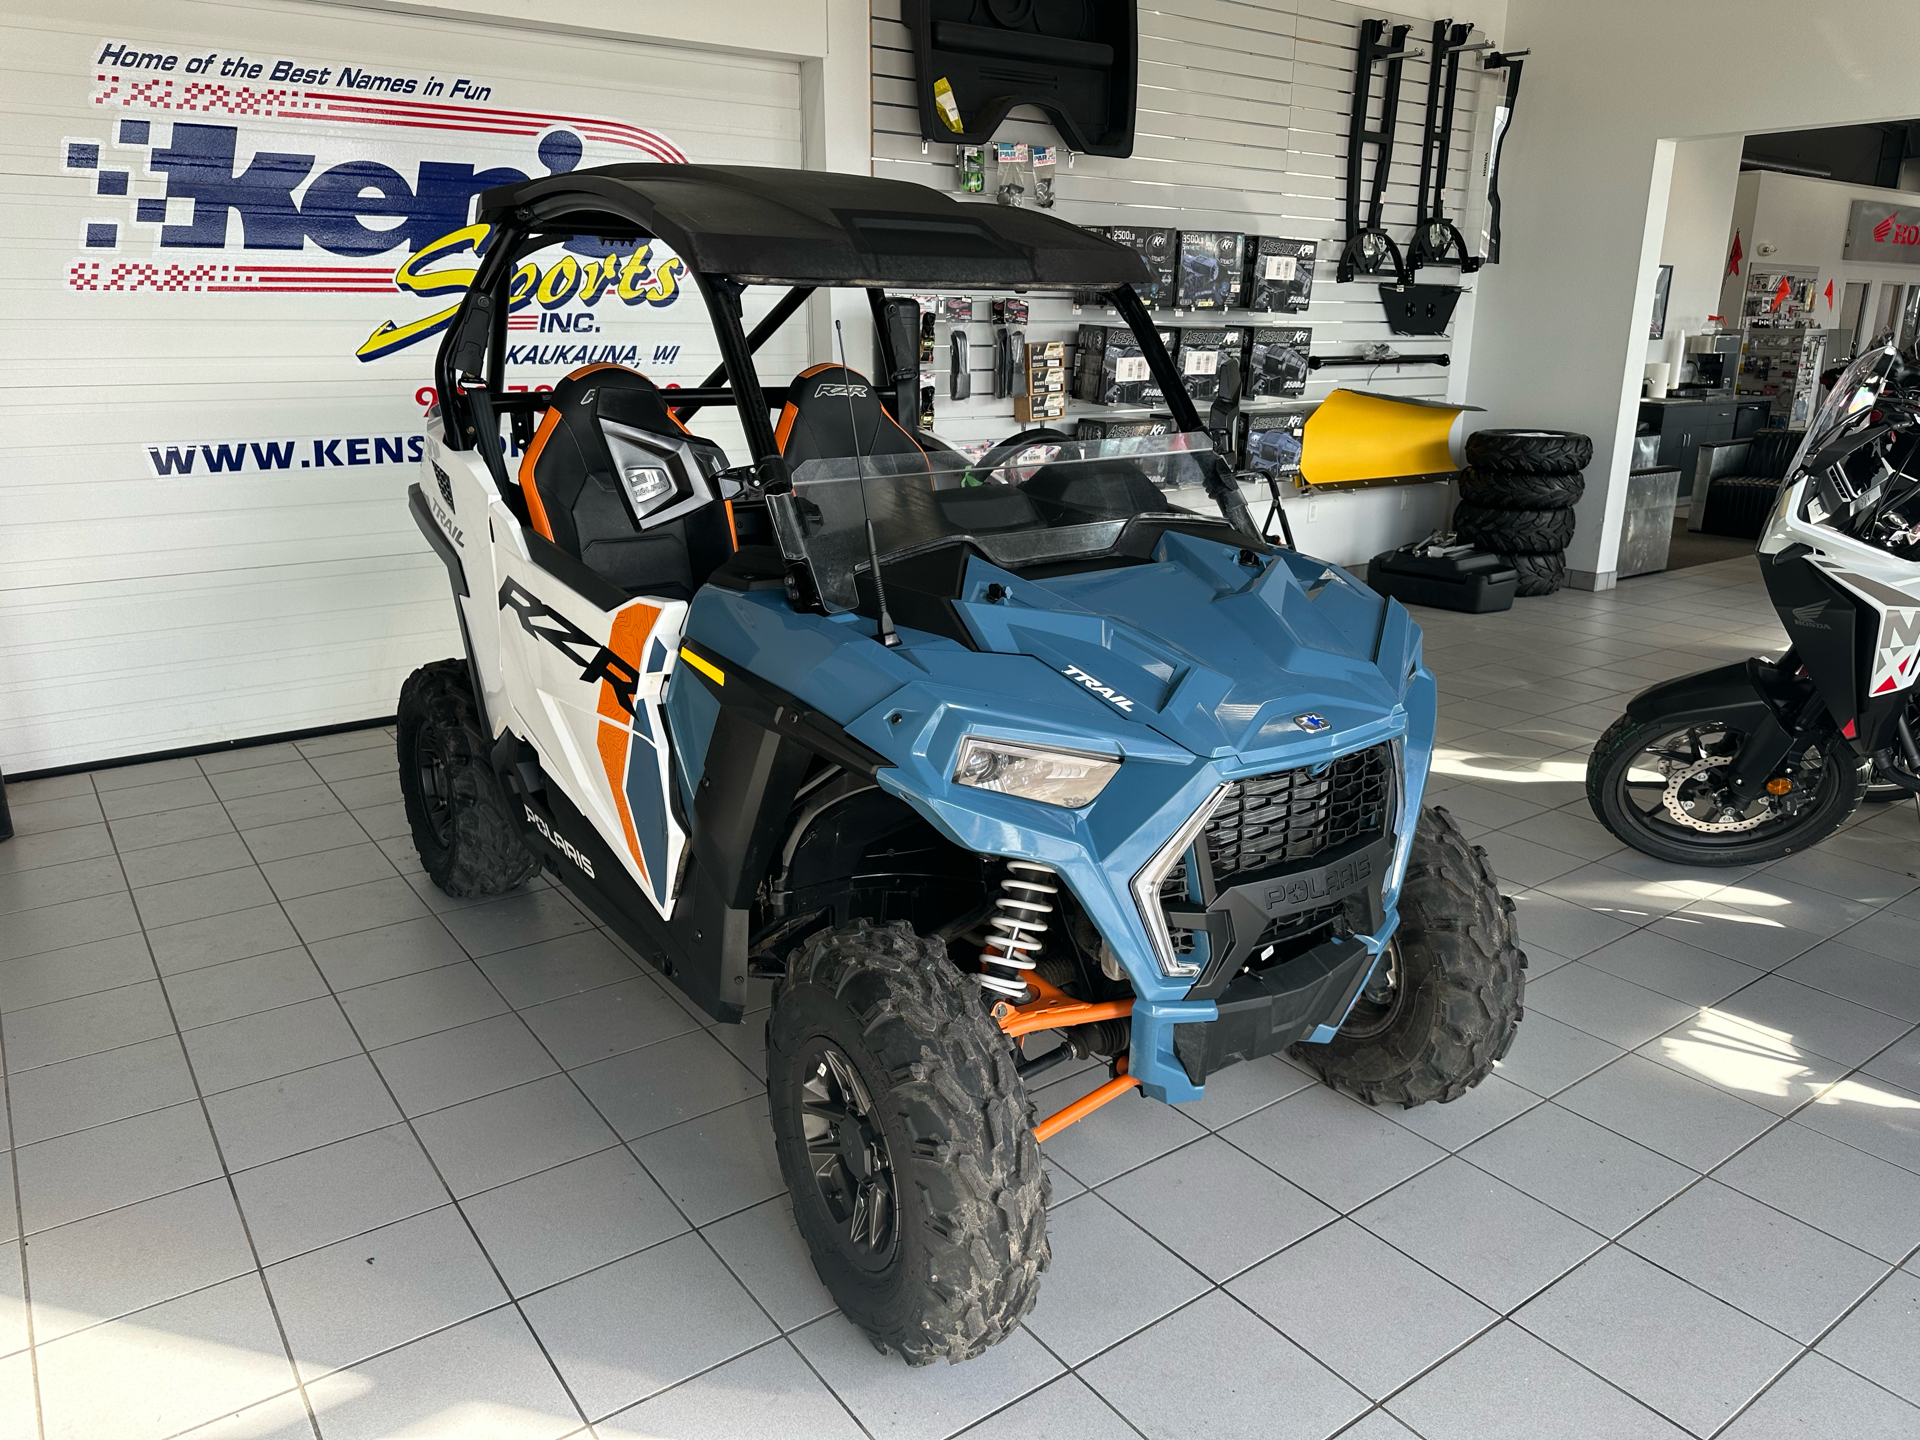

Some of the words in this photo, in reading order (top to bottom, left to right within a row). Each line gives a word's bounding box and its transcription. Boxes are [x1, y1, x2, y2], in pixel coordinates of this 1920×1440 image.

[98, 43, 178, 71] Home
[185, 54, 217, 74] of
[220, 57, 263, 79] the
[269, 61, 332, 86] Best
[336, 67, 418, 94] Names
[423, 76, 445, 97] in
[449, 79, 492, 101] Fun
[1892, 223, 1920, 247] HO
[540, 313, 600, 333] INC.
[505, 345, 642, 368] KAUKAUNA,
[652, 346, 680, 364] WI
[814, 384, 868, 398] RZR
[432, 497, 464, 548] TRAIL
[499, 575, 640, 722] RZR
[1794, 619, 1833, 631] HONDA
[1061, 664, 1135, 713] TRAIL
[523, 803, 596, 880] POLARIS
[1264, 855, 1373, 910] POLARIS
